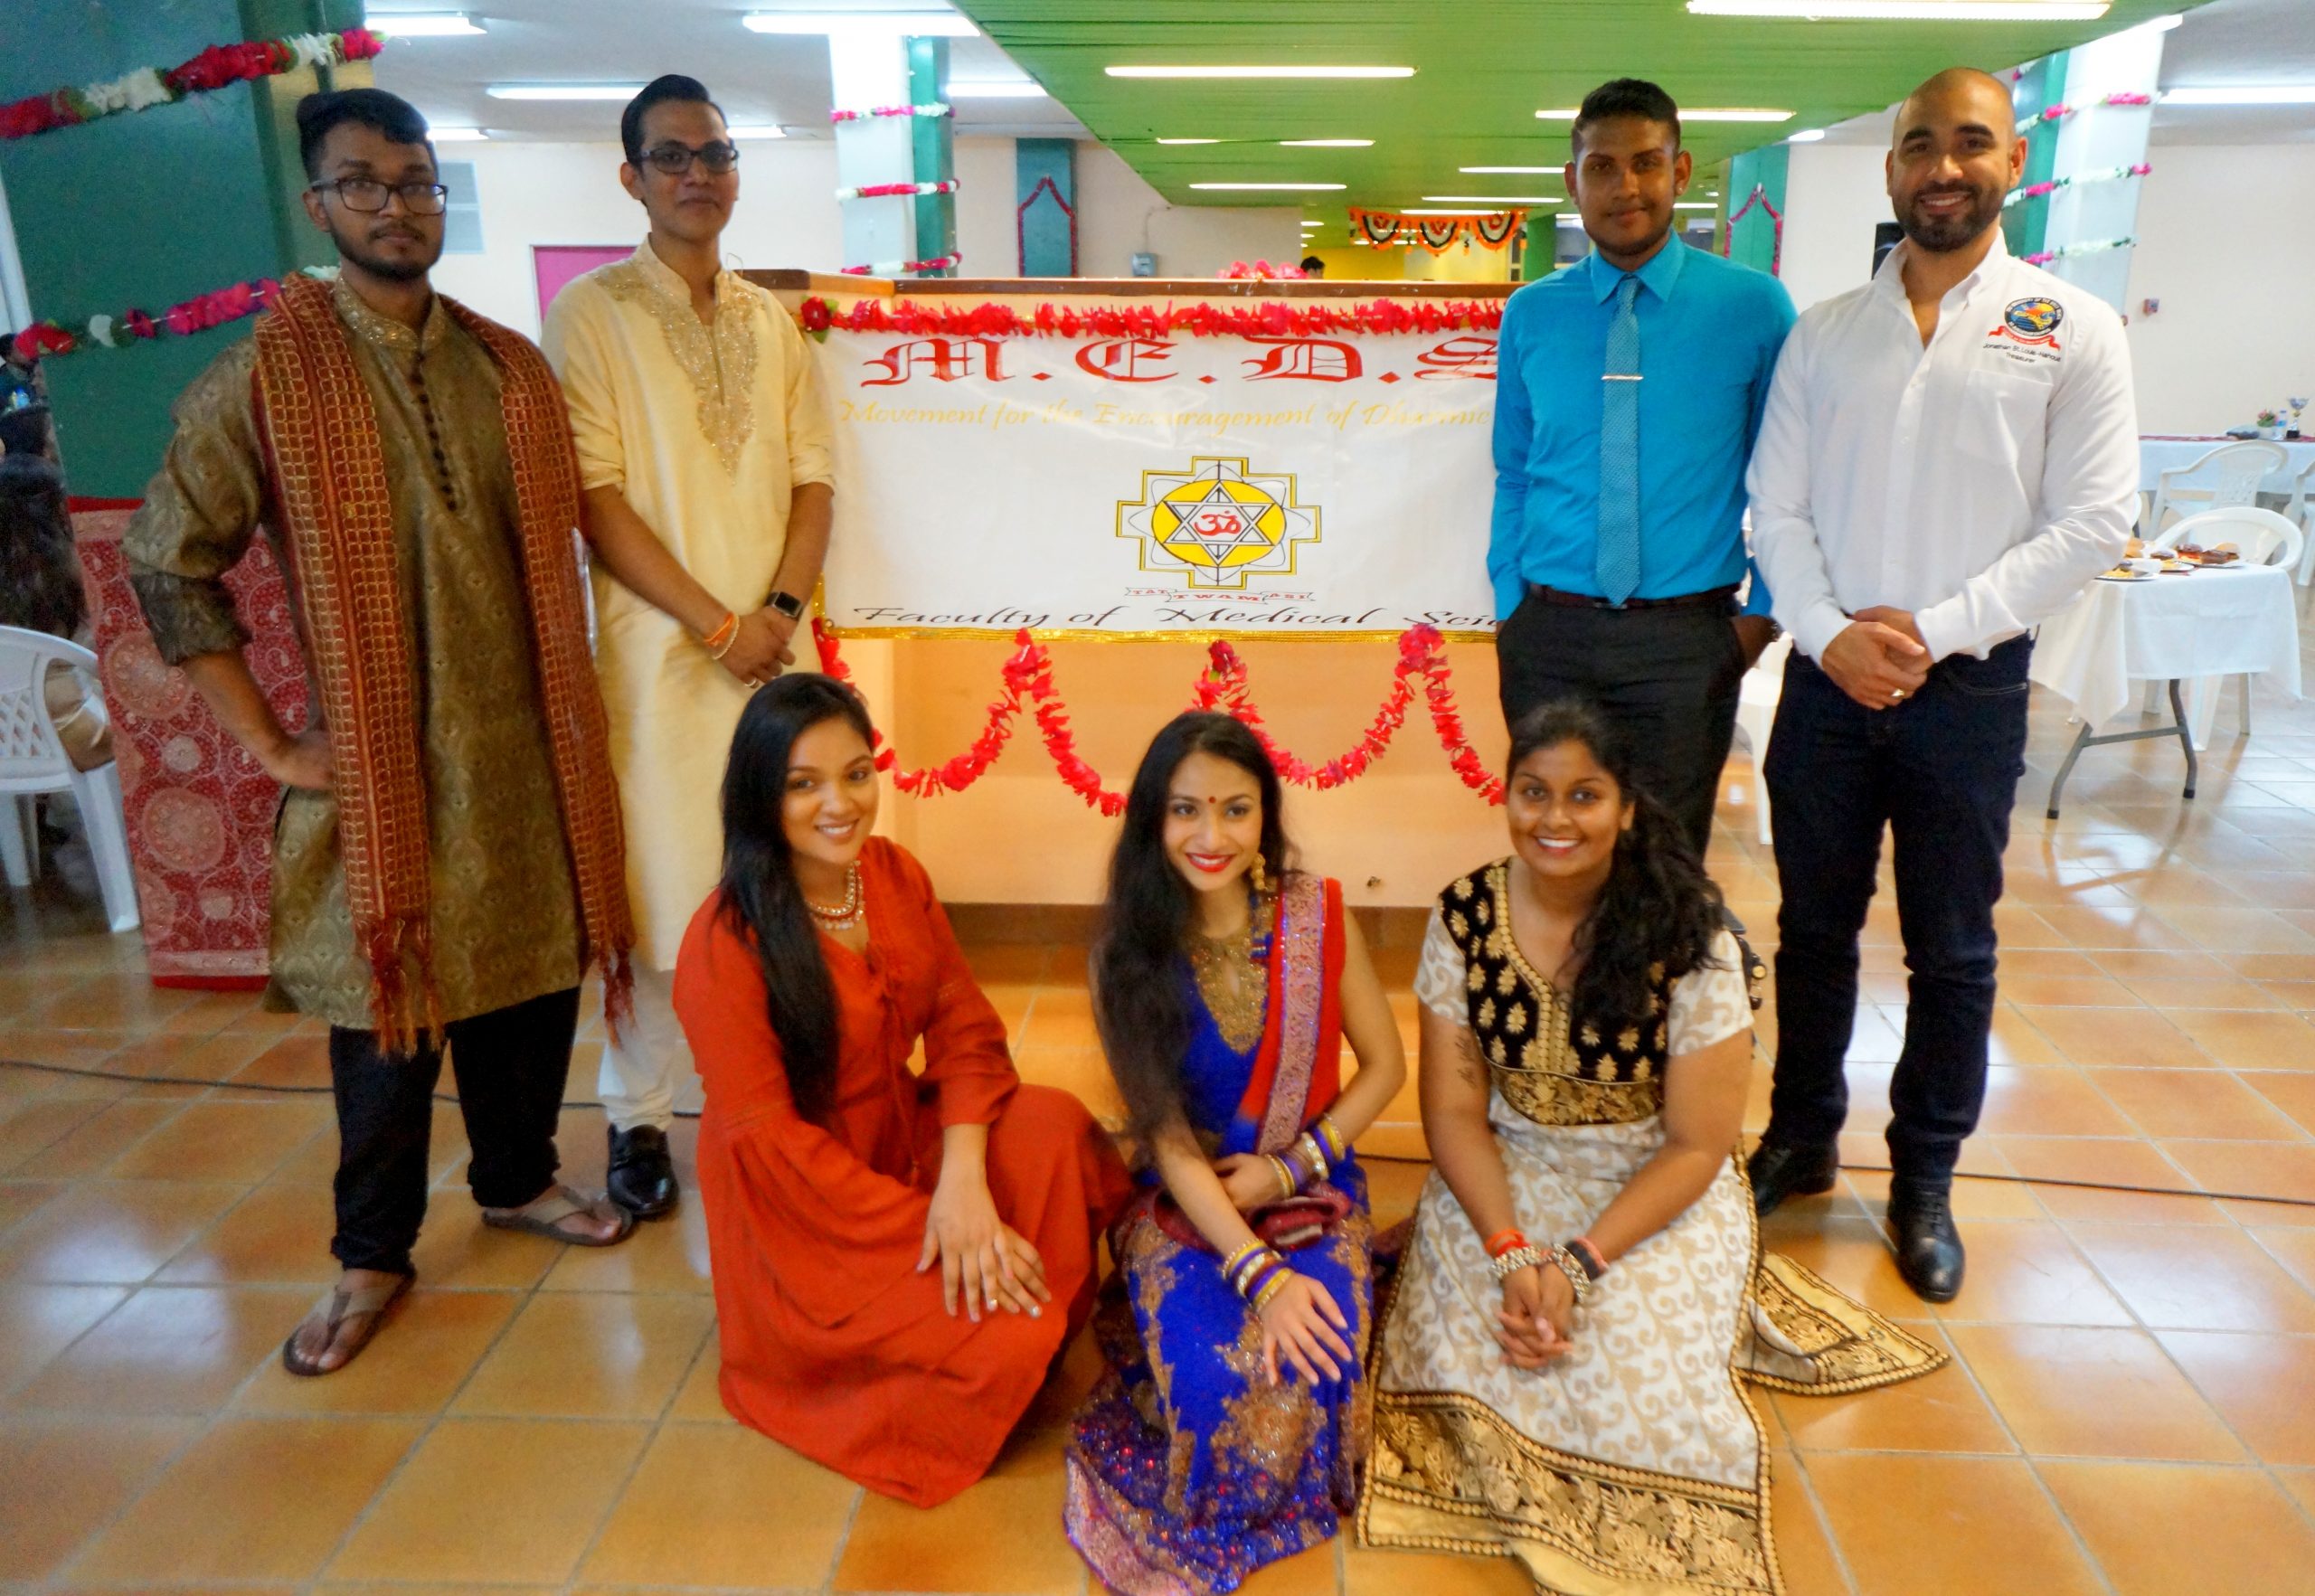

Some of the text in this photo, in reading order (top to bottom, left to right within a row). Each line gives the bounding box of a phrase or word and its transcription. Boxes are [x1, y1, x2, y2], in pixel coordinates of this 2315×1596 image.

[839, 400, 987, 424] Movement
[993, 399, 1035, 430] for
[1042, 398, 1083, 424] the
[1327, 400, 1360, 431] of
[1174, 593, 1260, 602] TWAM
[1270, 592, 1307, 600] ASI
[854, 606, 1051, 628] Faculty
[1069, 605, 1131, 627] of
[1154, 606, 1388, 624] Medical
